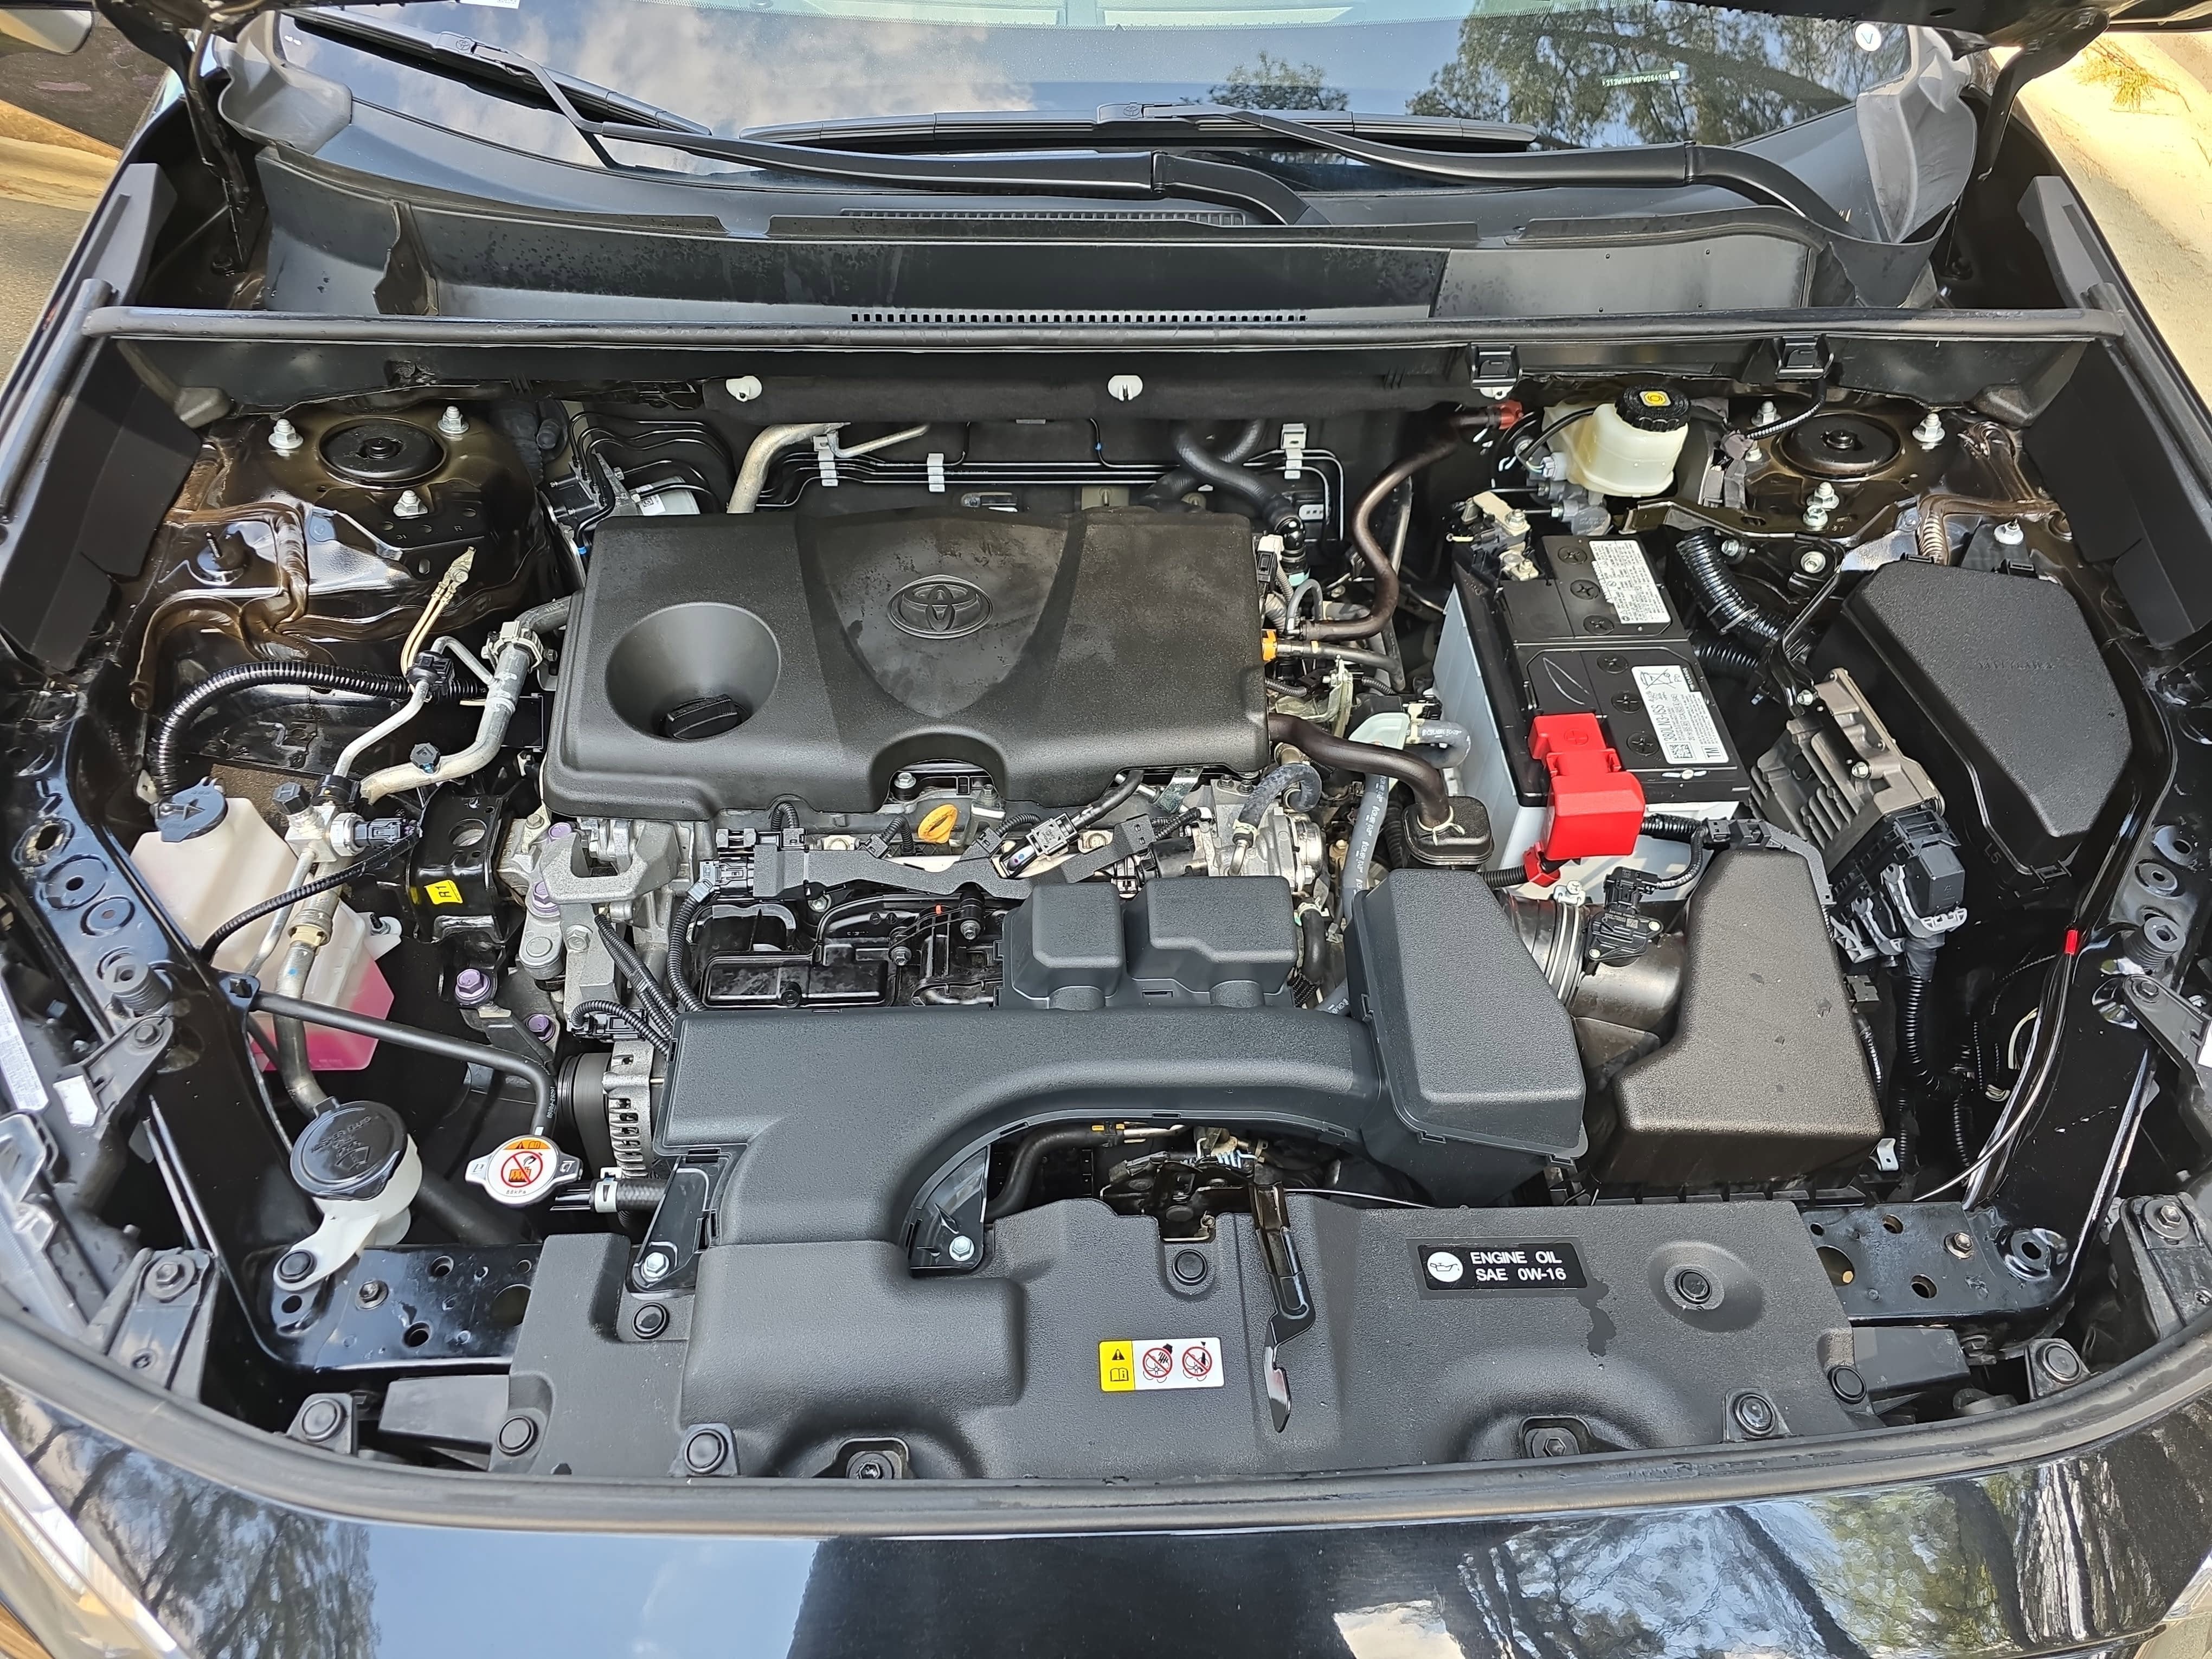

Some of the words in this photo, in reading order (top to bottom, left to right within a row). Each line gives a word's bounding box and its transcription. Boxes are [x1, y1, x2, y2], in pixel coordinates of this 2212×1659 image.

[1674, 674, 1682, 682] Pb
[1651, 704, 1677, 741] 380LN3-ISS
[1705, 747, 1721, 758] TM
[277, 785, 297, 798] H
[1984, 843, 2002, 863] L5
[435, 886, 452, 897] R1
[1470, 1251, 1528, 1264] ENGINE
[1535, 1251, 1562, 1264] OIL
[1475, 1268, 1509, 1282] SAE
[1517, 1268, 1567, 1281] 0W-16
